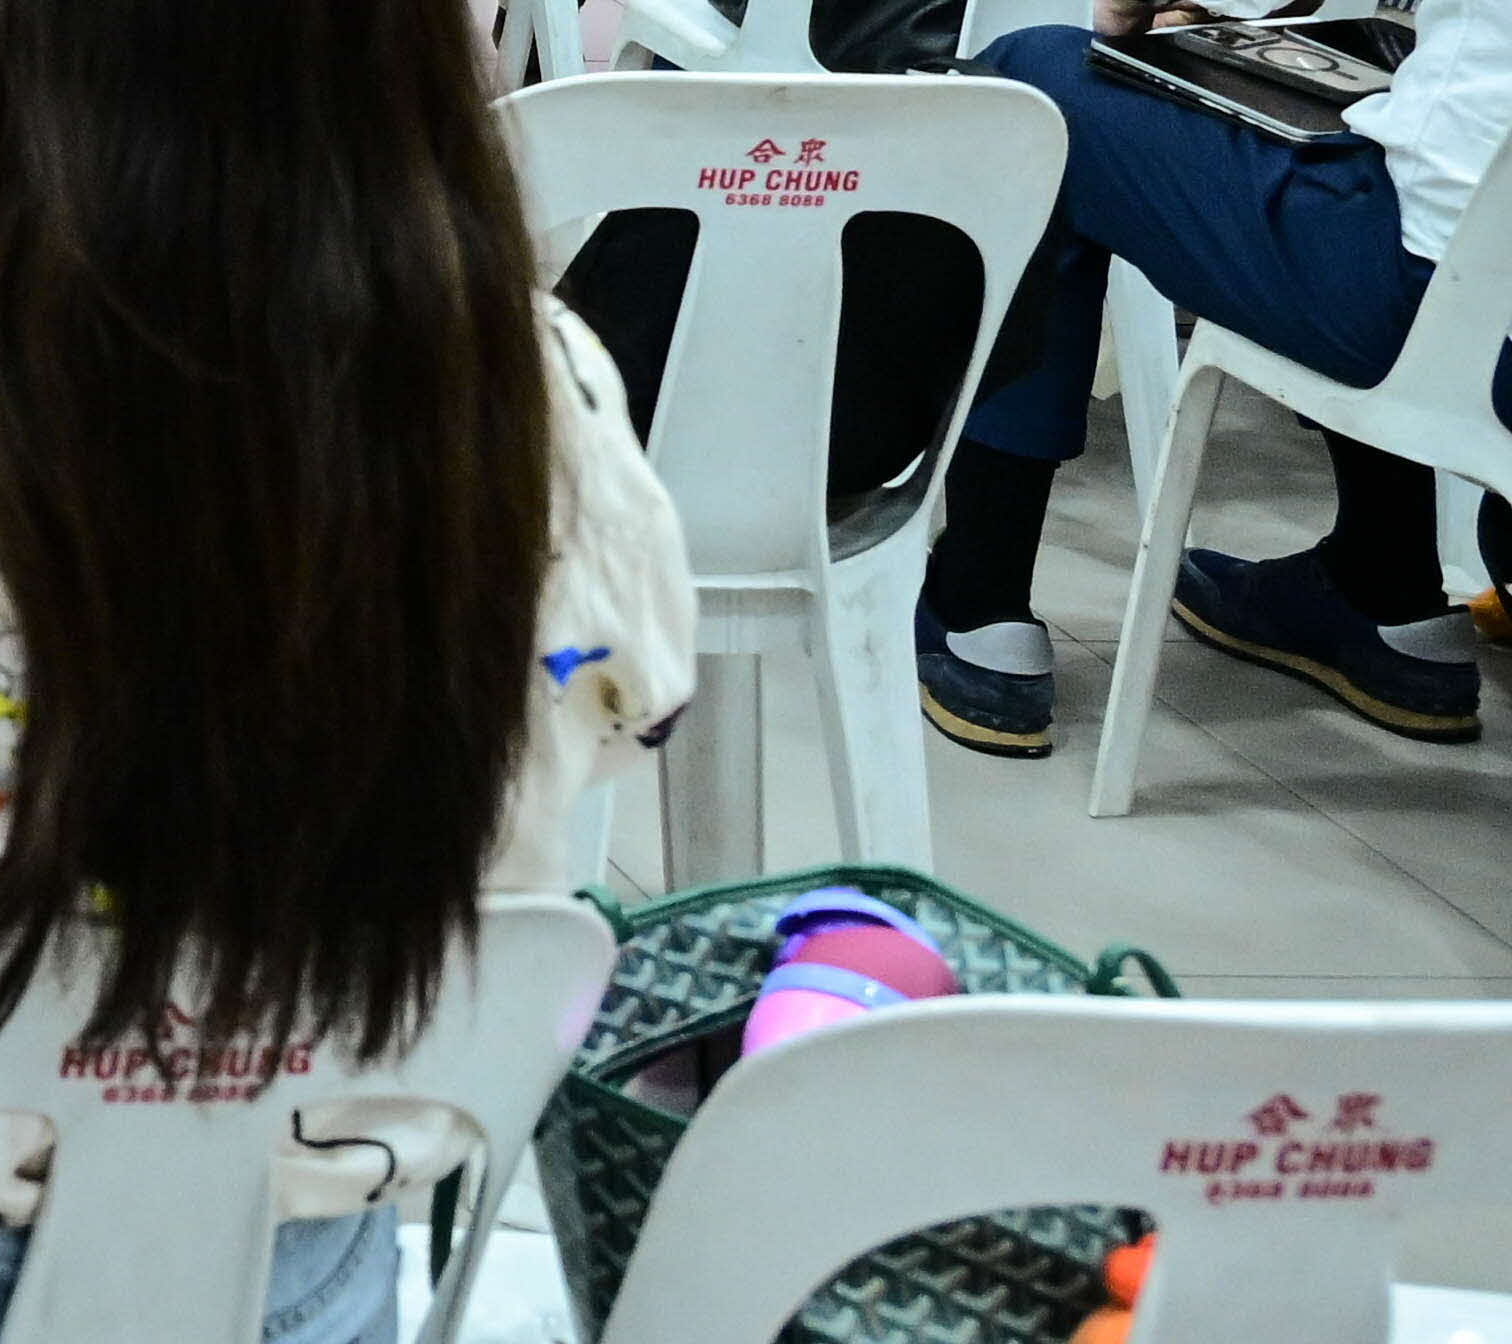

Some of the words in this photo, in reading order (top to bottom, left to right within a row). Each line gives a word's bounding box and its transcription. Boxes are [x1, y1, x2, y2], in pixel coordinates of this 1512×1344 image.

[698, 168, 755, 189] HUP
[766, 170, 859, 191] CHUNG
[725, 193, 772, 206] 6368
[779, 195, 824, 206] 8088
[168, 1043, 311, 1079] CUG
[1159, 1141, 1259, 1173] HUP
[1276, 1137, 1435, 1173] CHUNG
